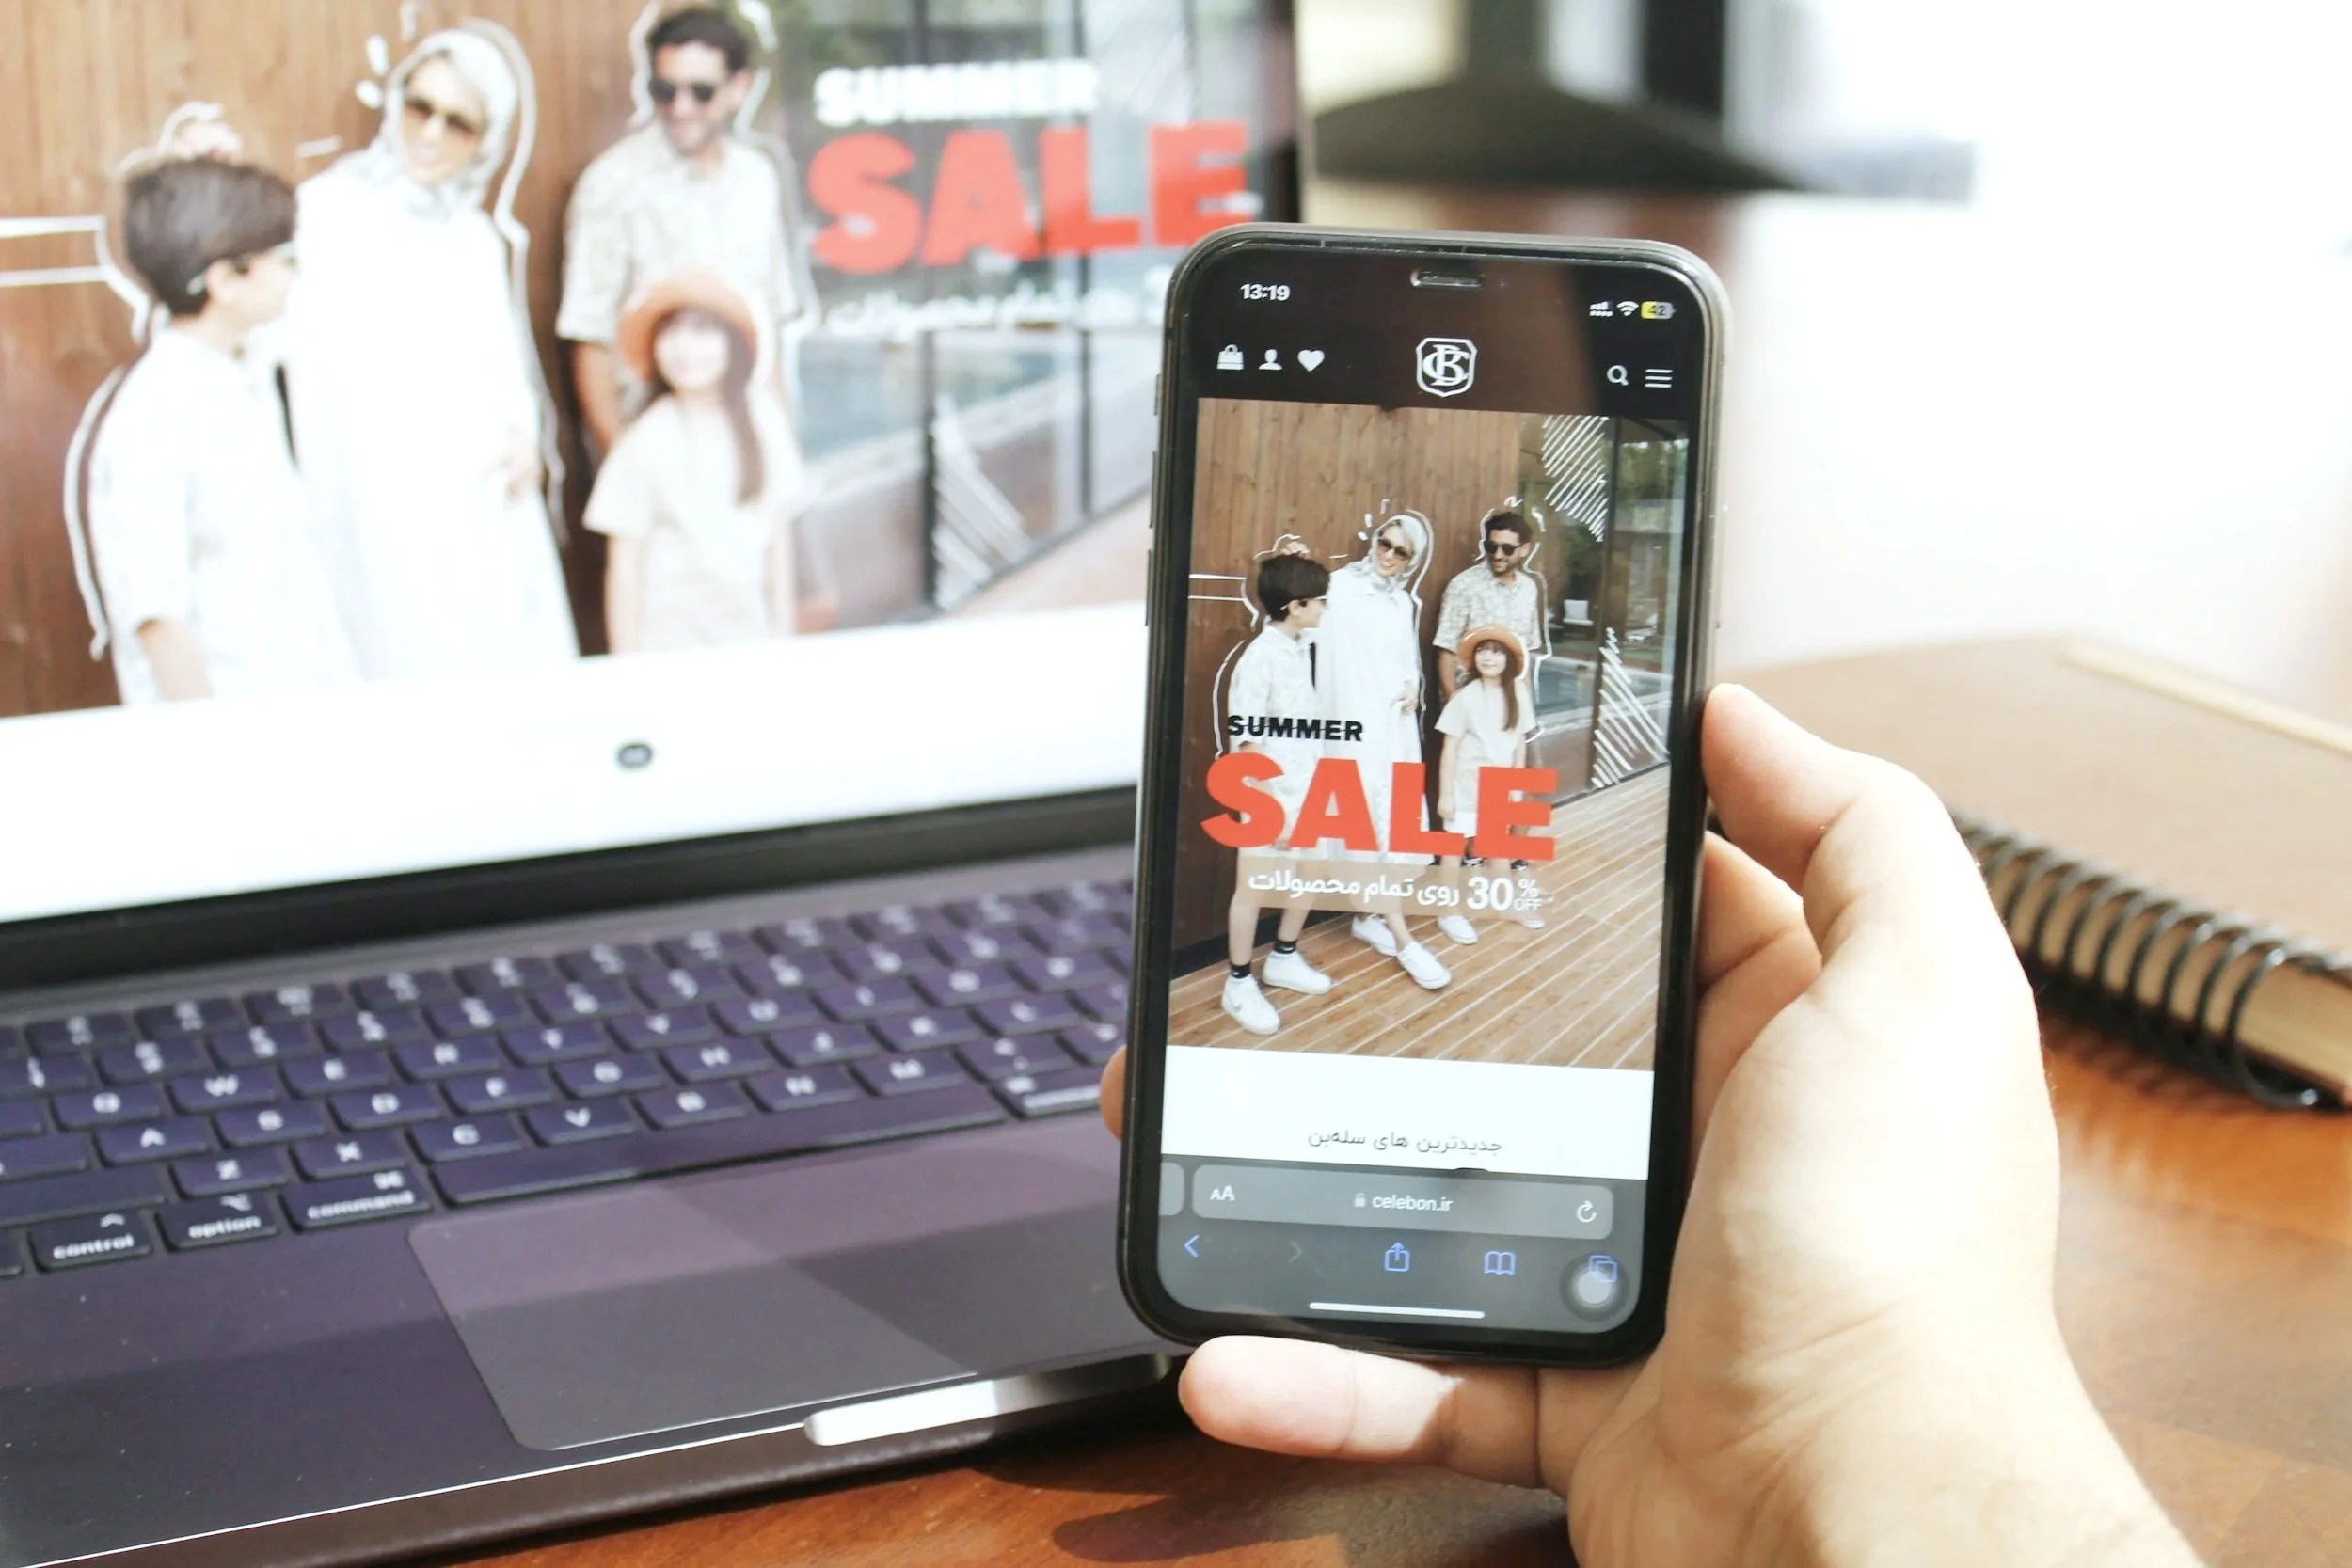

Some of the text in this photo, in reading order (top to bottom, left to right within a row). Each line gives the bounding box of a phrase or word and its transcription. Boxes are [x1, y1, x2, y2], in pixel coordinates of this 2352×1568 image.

[808, 121, 1253, 275] SALE
[1241, 283, 1290, 302] 13:19
[1227, 715, 1363, 742] SUMMER
[1200, 752, 1559, 861] SALE
[1248, 869, 1360, 899] محصولات
[1363, 874, 1414, 904] تمام
[1417, 884, 1459, 906] روی
[1467, 876, 1514, 911] 30
[1373, 1132, 1409, 1150] های
[307, 1189, 416, 1220] command
[1372, 1194, 1454, 1212] celebon.ir
[188, 1214, 262, 1240] option
[53, 1233, 135, 1259] control
